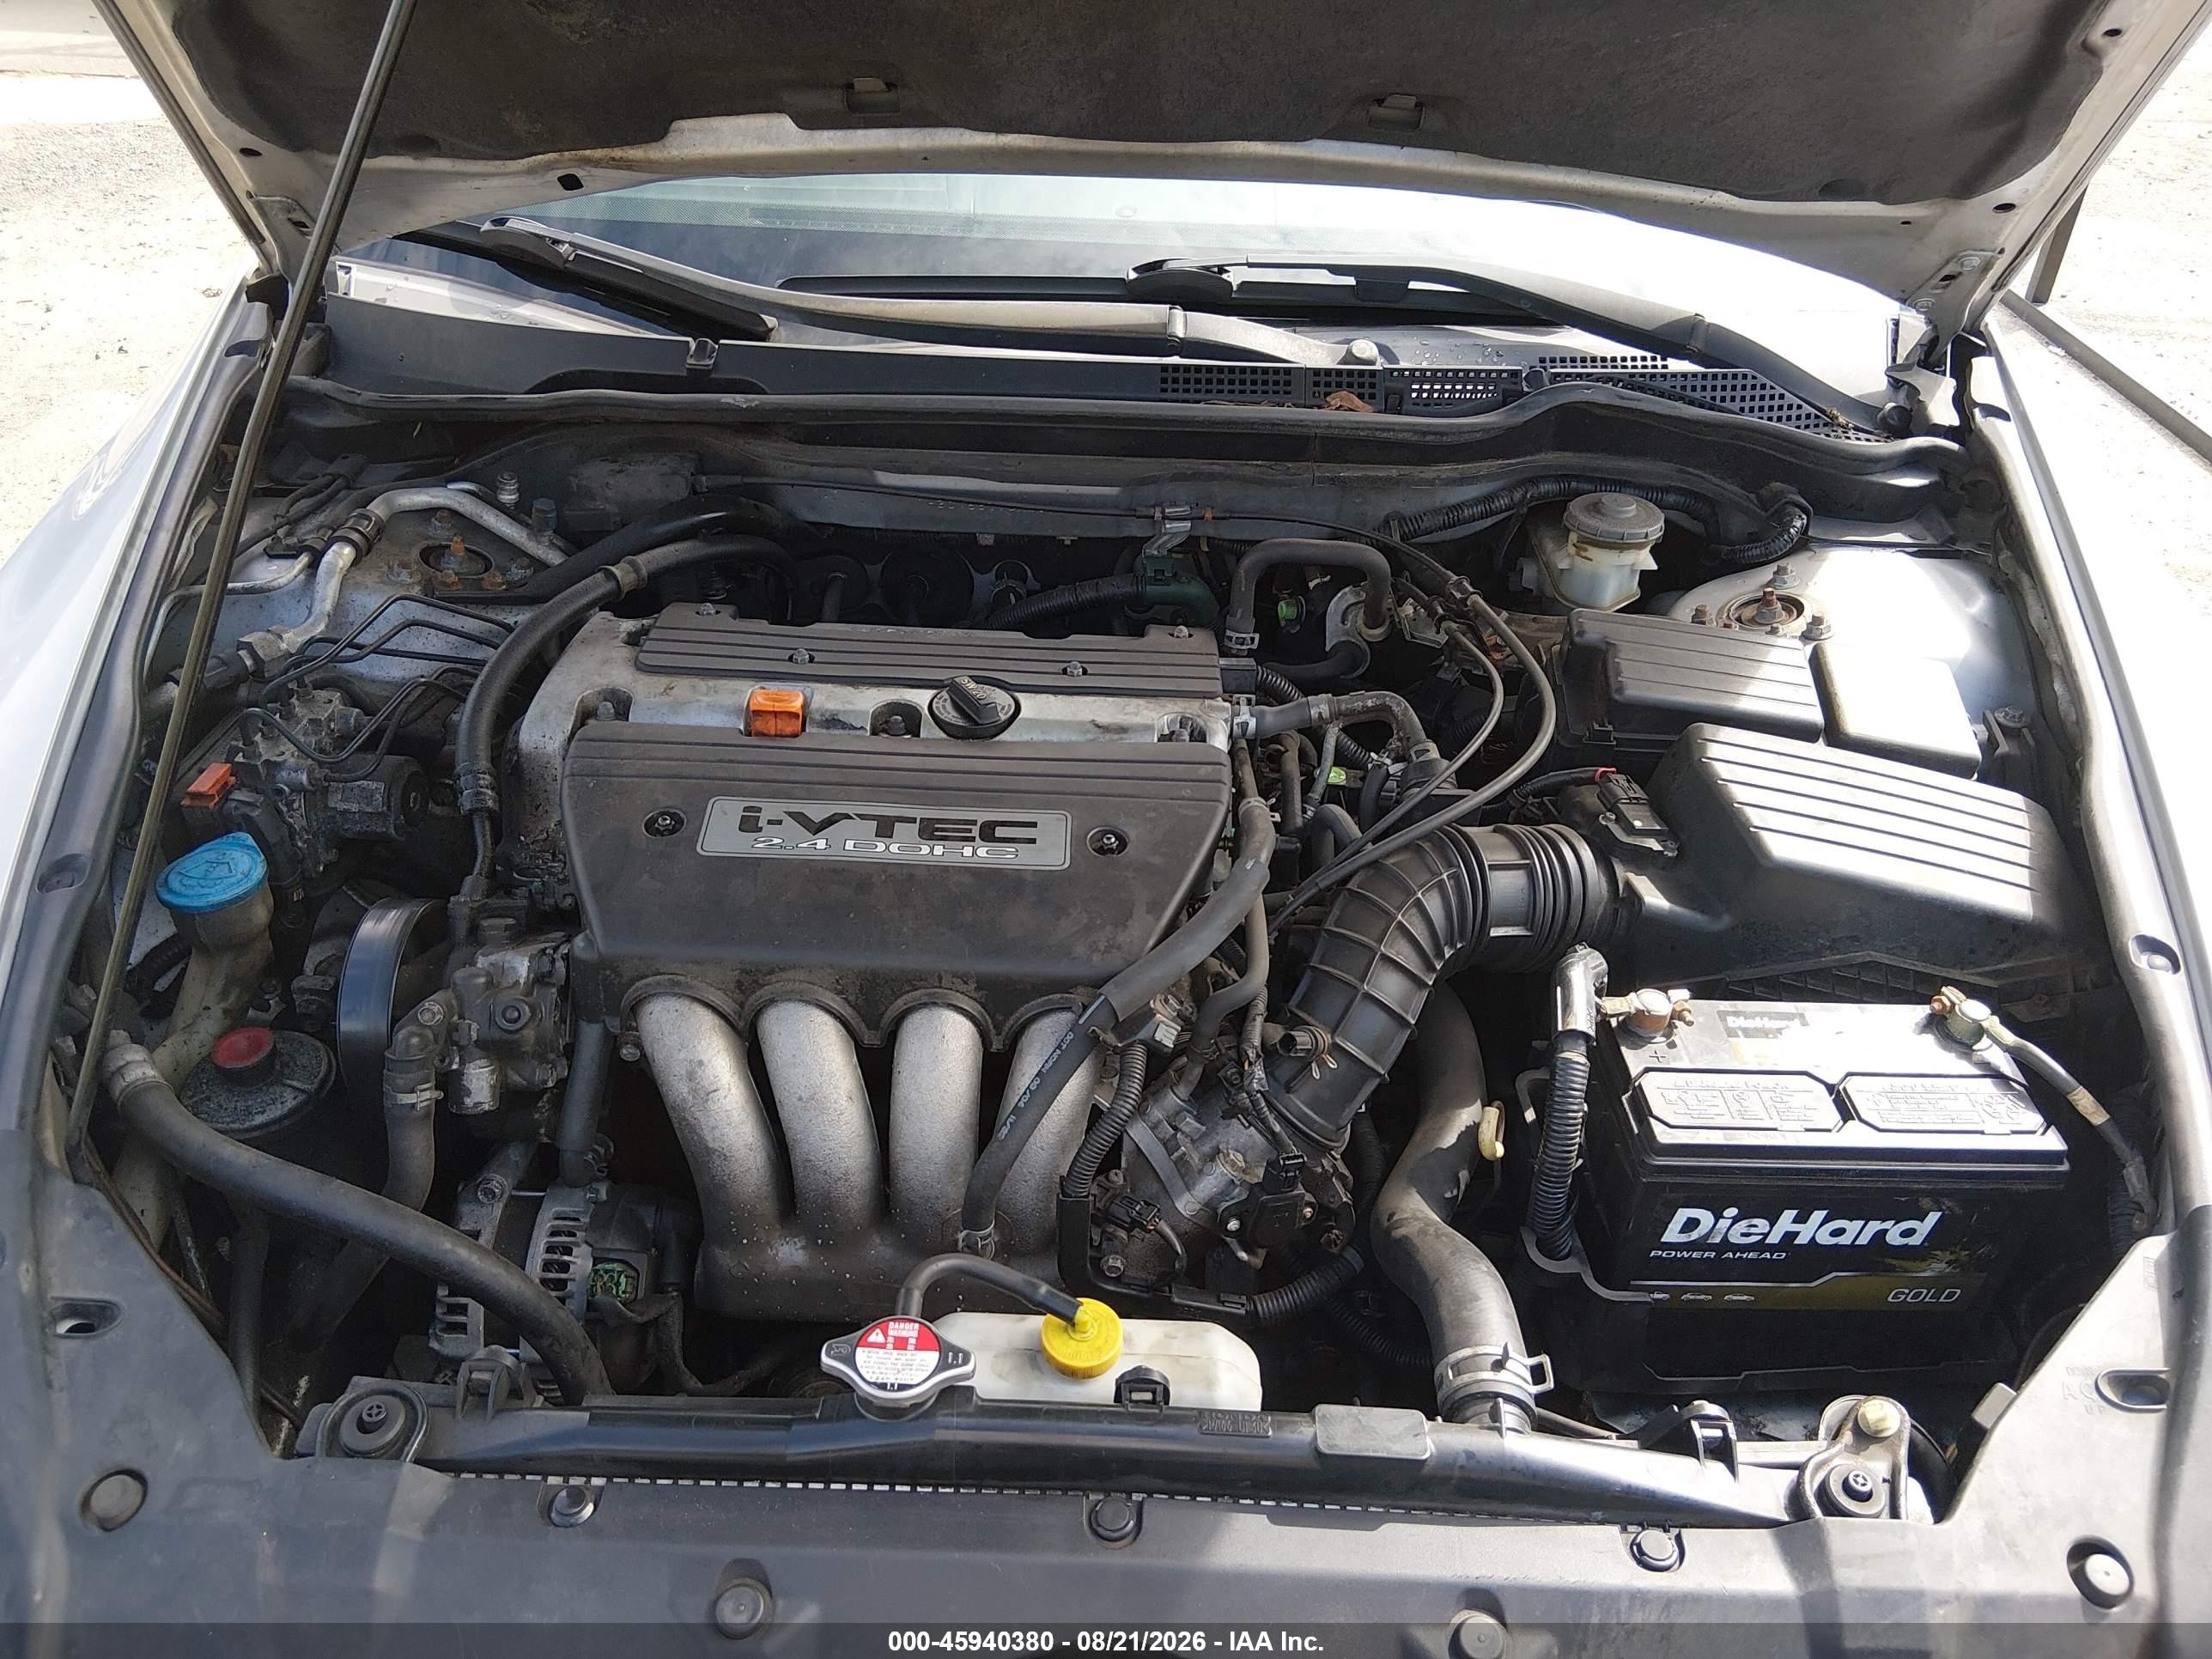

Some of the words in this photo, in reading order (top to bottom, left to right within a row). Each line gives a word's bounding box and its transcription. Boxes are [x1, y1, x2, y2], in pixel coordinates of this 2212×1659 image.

[738, 805, 1038, 846] i-VTEC
[751, 836, 831, 851] 2.4
[843, 838, 1019, 859] DOHC
[1660, 1206, 1944, 1246] DieHard
[1650, 1250, 1717, 1259] POWER
[1721, 1251, 1787, 1260] AHEAD
[1887, 1288, 1962, 1303] GOLD
[888, 1322, 919, 1330] DANGER
